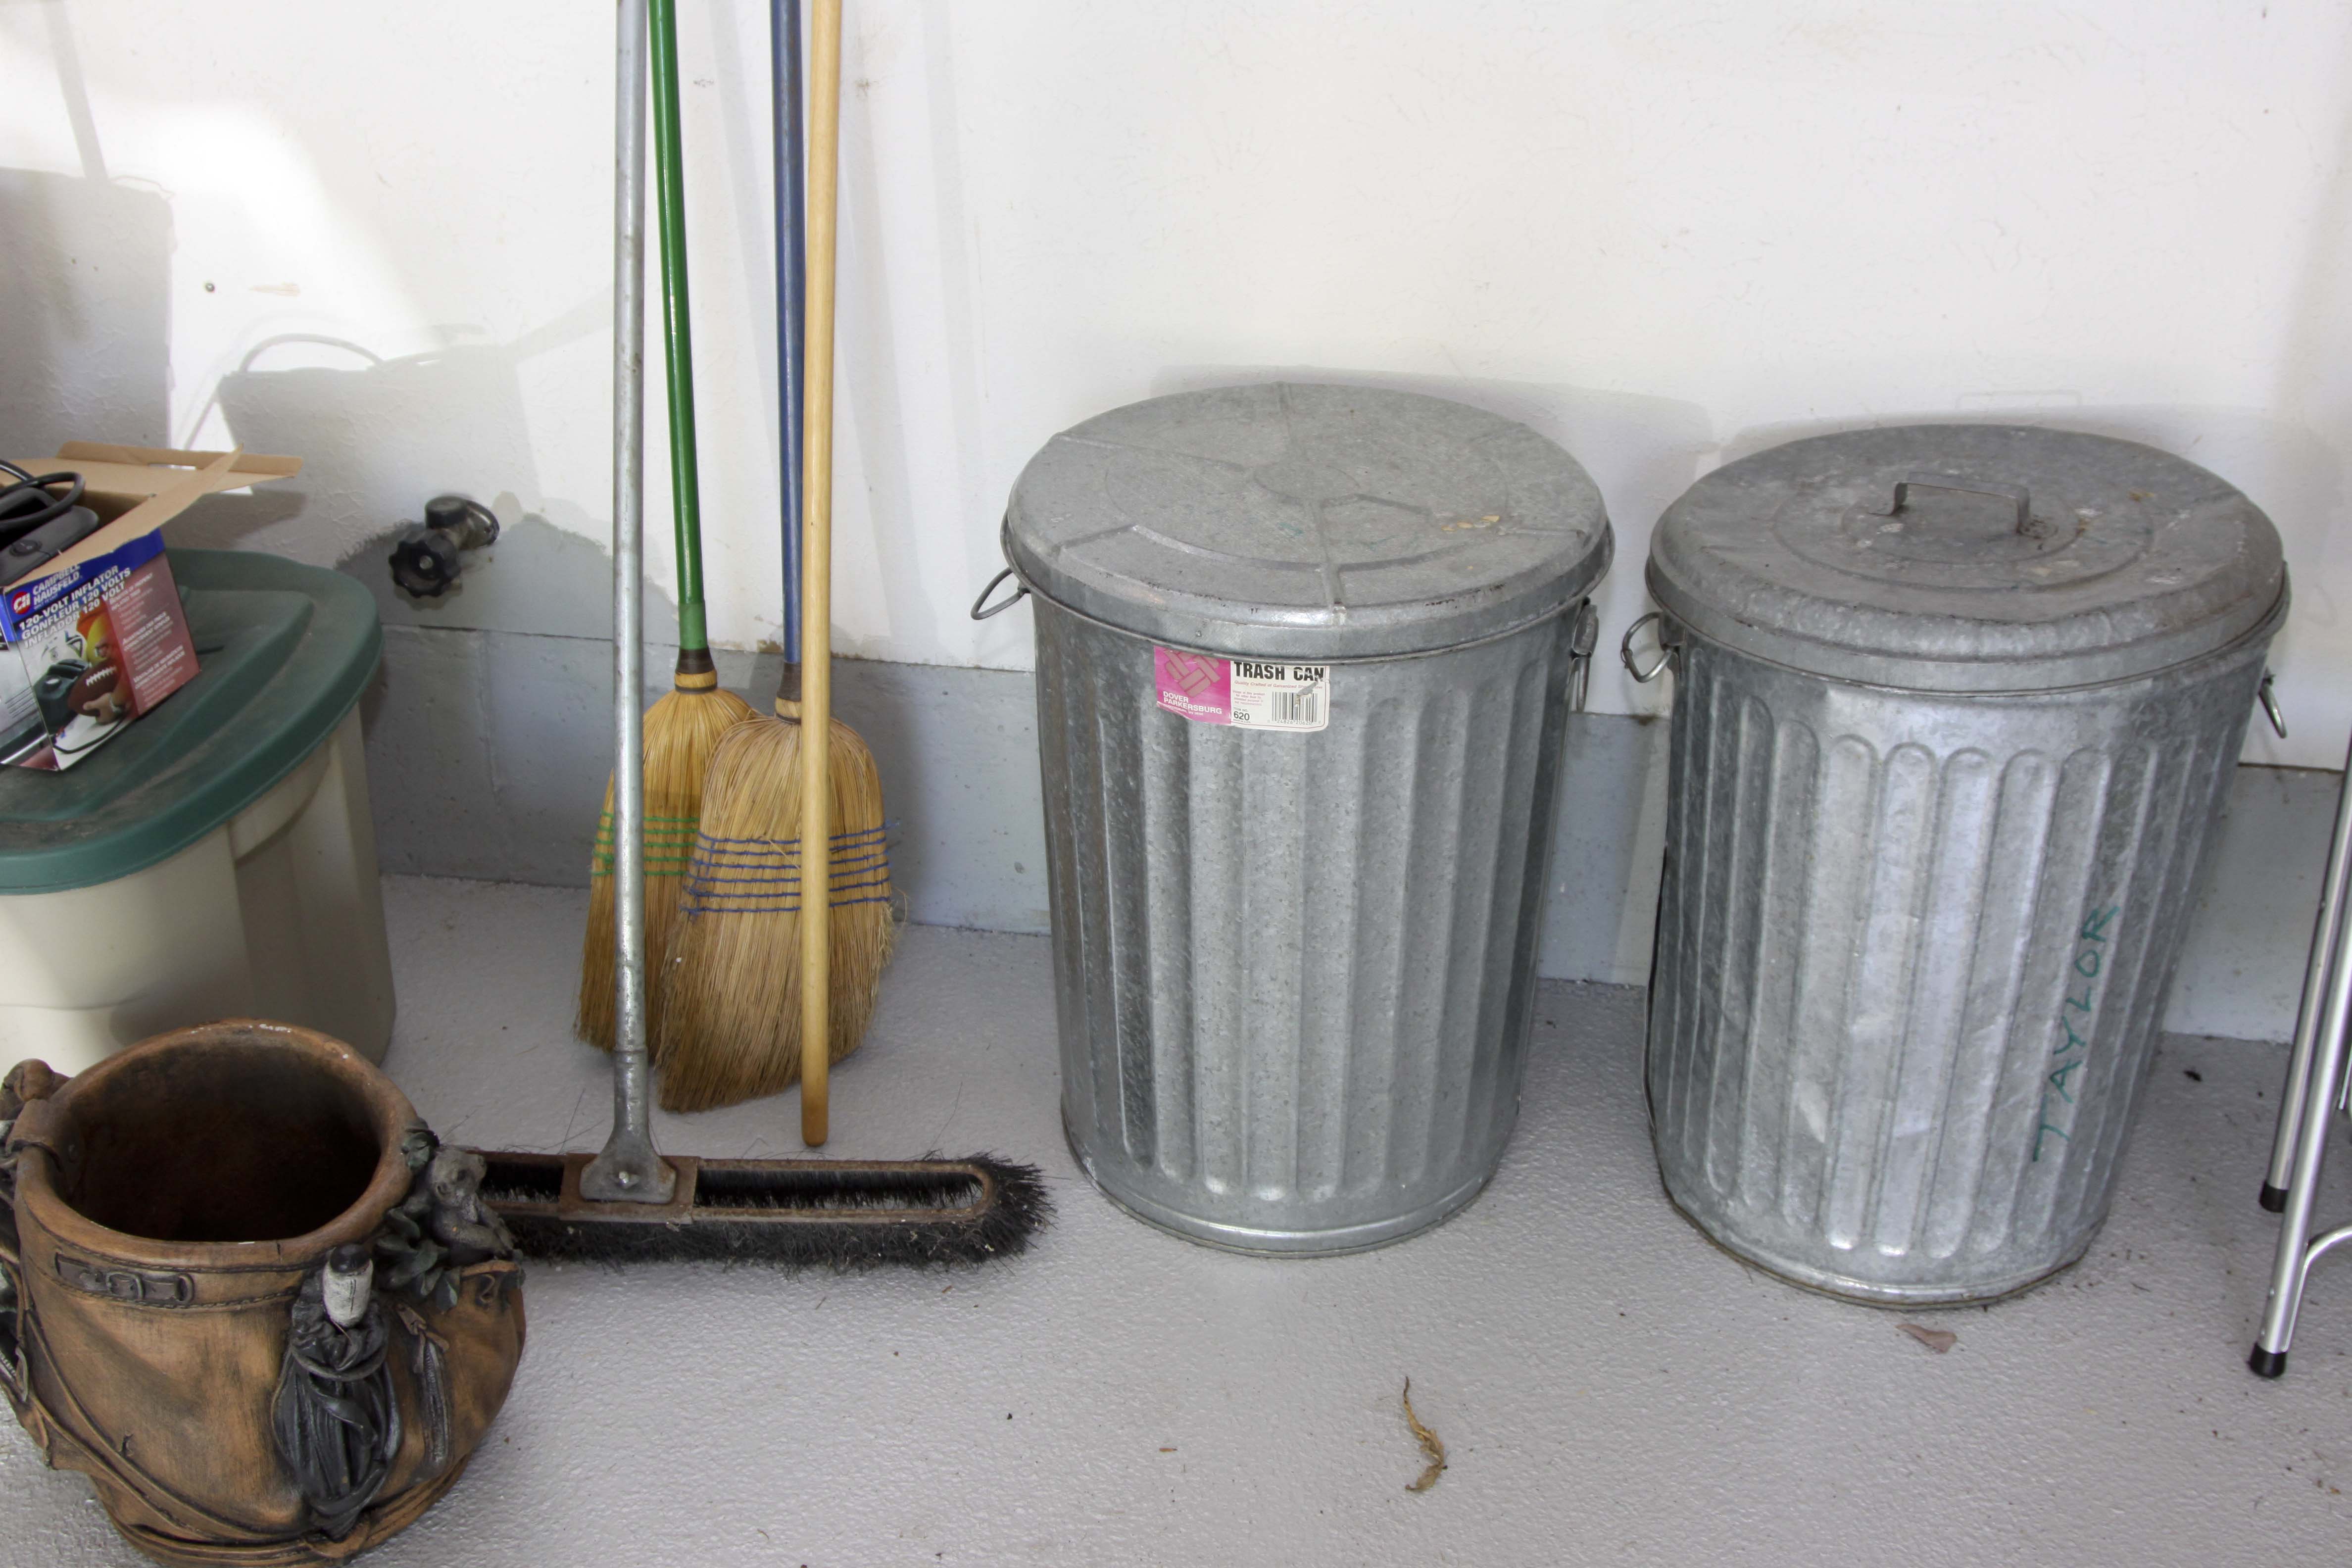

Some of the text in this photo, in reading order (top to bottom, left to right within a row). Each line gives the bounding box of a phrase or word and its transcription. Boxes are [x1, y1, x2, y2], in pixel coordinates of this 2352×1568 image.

[19, 596, 70, 631] 120-VOLT
[71, 565, 119, 601] INFLATOR
[21, 601, 80, 640] GONFLEUR
[82, 588, 99, 605] 120
[100, 567, 132, 592] VOLTS
[33, 572, 80, 605] HAUSFELD
[23, 611, 81, 649] INFLADOR
[83, 599, 100, 614] 120
[101, 581, 126, 601] VOLT
[1234, 661, 1324, 682] TRASH CAN
[1163, 690, 1189, 703] DOVER
[1163, 697, 1223, 714] PARKERSBURG
[1233, 711, 1250, 721] 620
[2032, 905, 2120, 1162] TAYLOR
